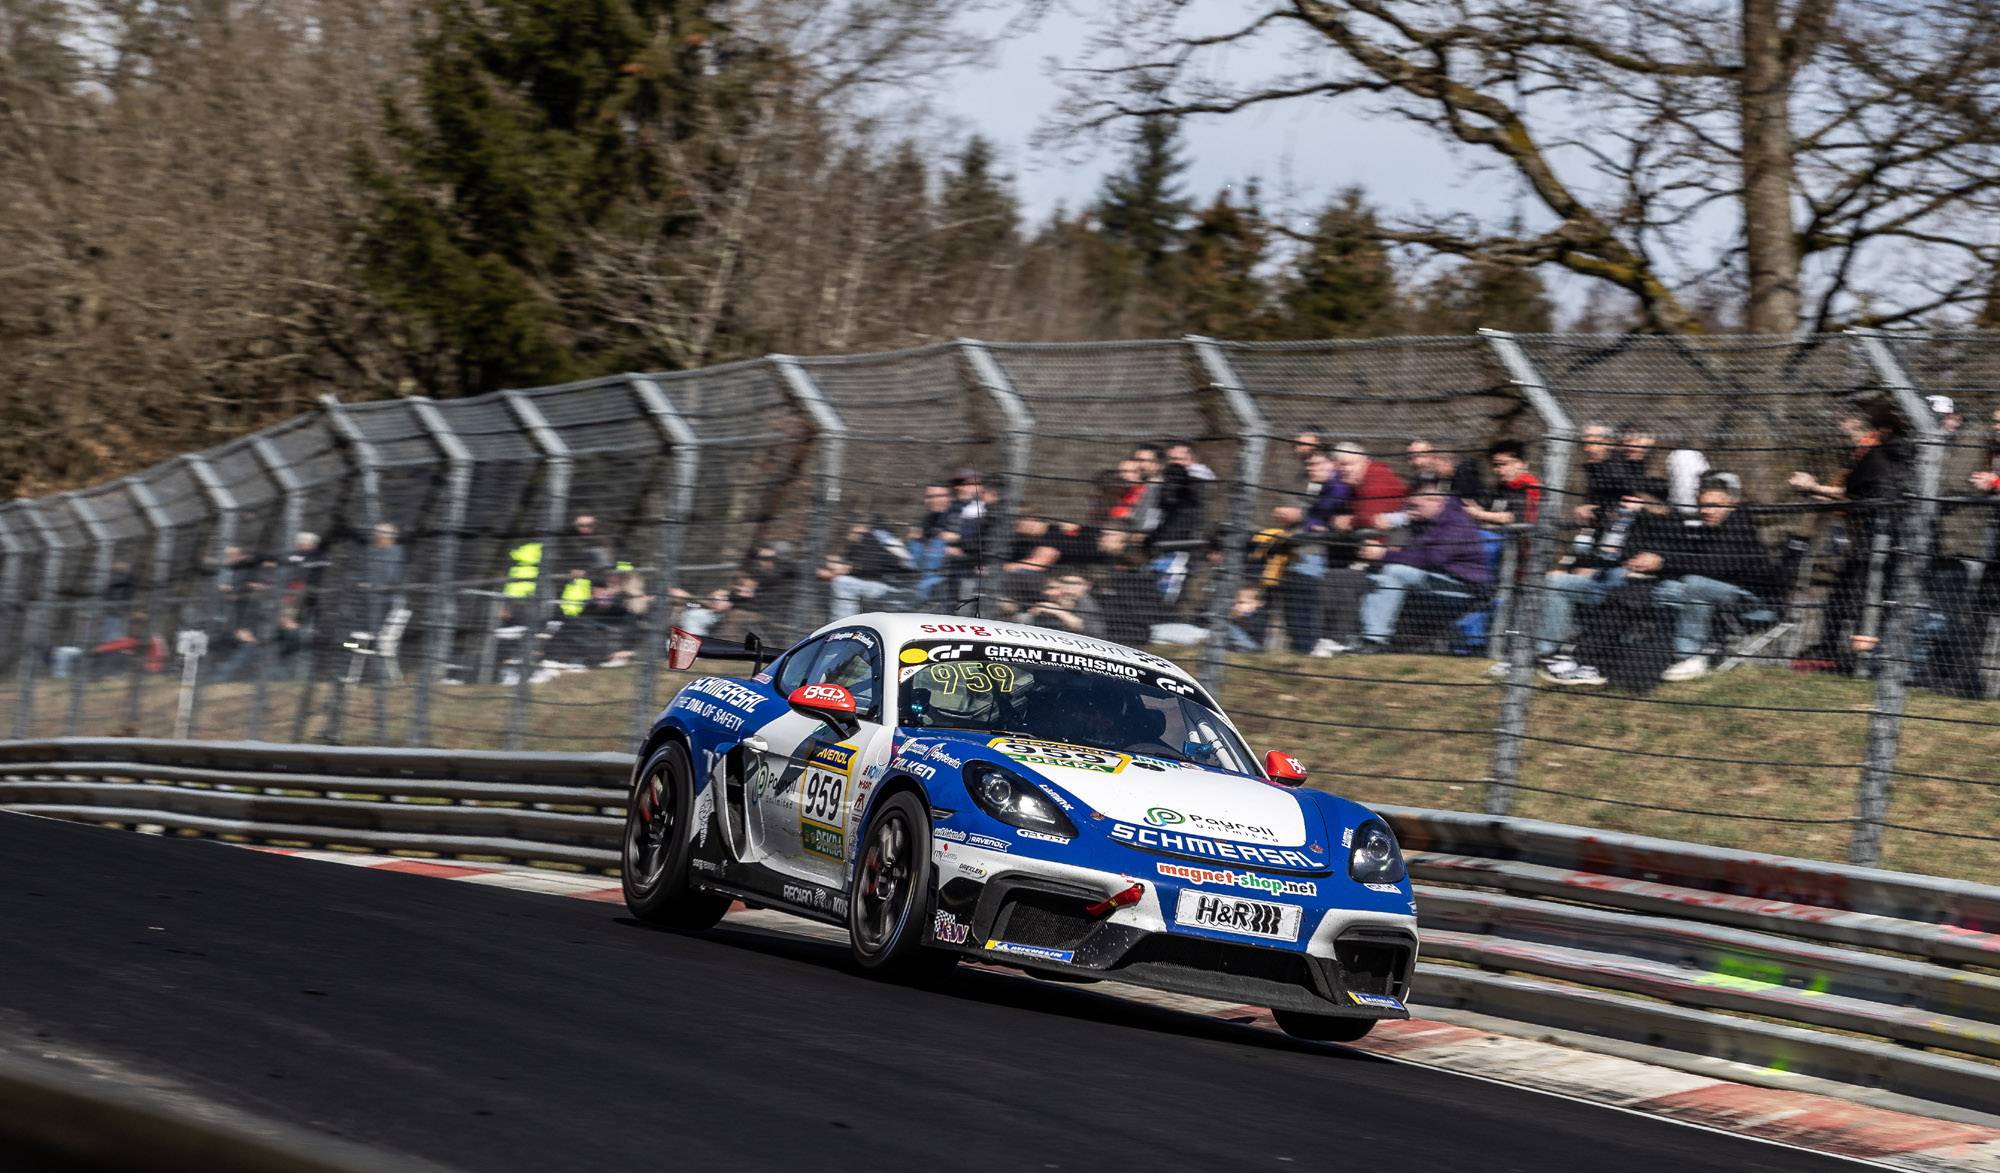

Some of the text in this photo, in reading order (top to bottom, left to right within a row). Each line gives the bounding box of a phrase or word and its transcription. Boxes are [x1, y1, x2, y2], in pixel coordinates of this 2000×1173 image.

[920, 624, 1131, 658] sorg rennsport
[984, 645, 1042, 660] GRAN
[930, 662, 1015, 695] 959
[1040, 661, 1082, 671] DRIVING
[1083, 667, 1141, 684] SIMULATOR
[685, 698, 705, 714] DNA
[702, 703, 717, 718] OF
[712, 708, 745, 732] SAFETY
[816, 748, 849, 765] AVENOL
[1005, 744, 1107, 764] 959
[1025, 755, 1107, 773] DEKRA
[767, 772, 798, 795] Paoll
[804, 771, 842, 822] 959
[1188, 814, 1275, 837] Payroll
[970, 835, 1005, 849] RAVENOL
[1110, 822, 1326, 869] SCHMERSAL
[958, 863, 984, 875] DREXLER
[1157, 861, 1317, 897] magnet-shop.net
[783, 884, 813, 905] RECARO
[1195, 895, 1255, 931] H&R
